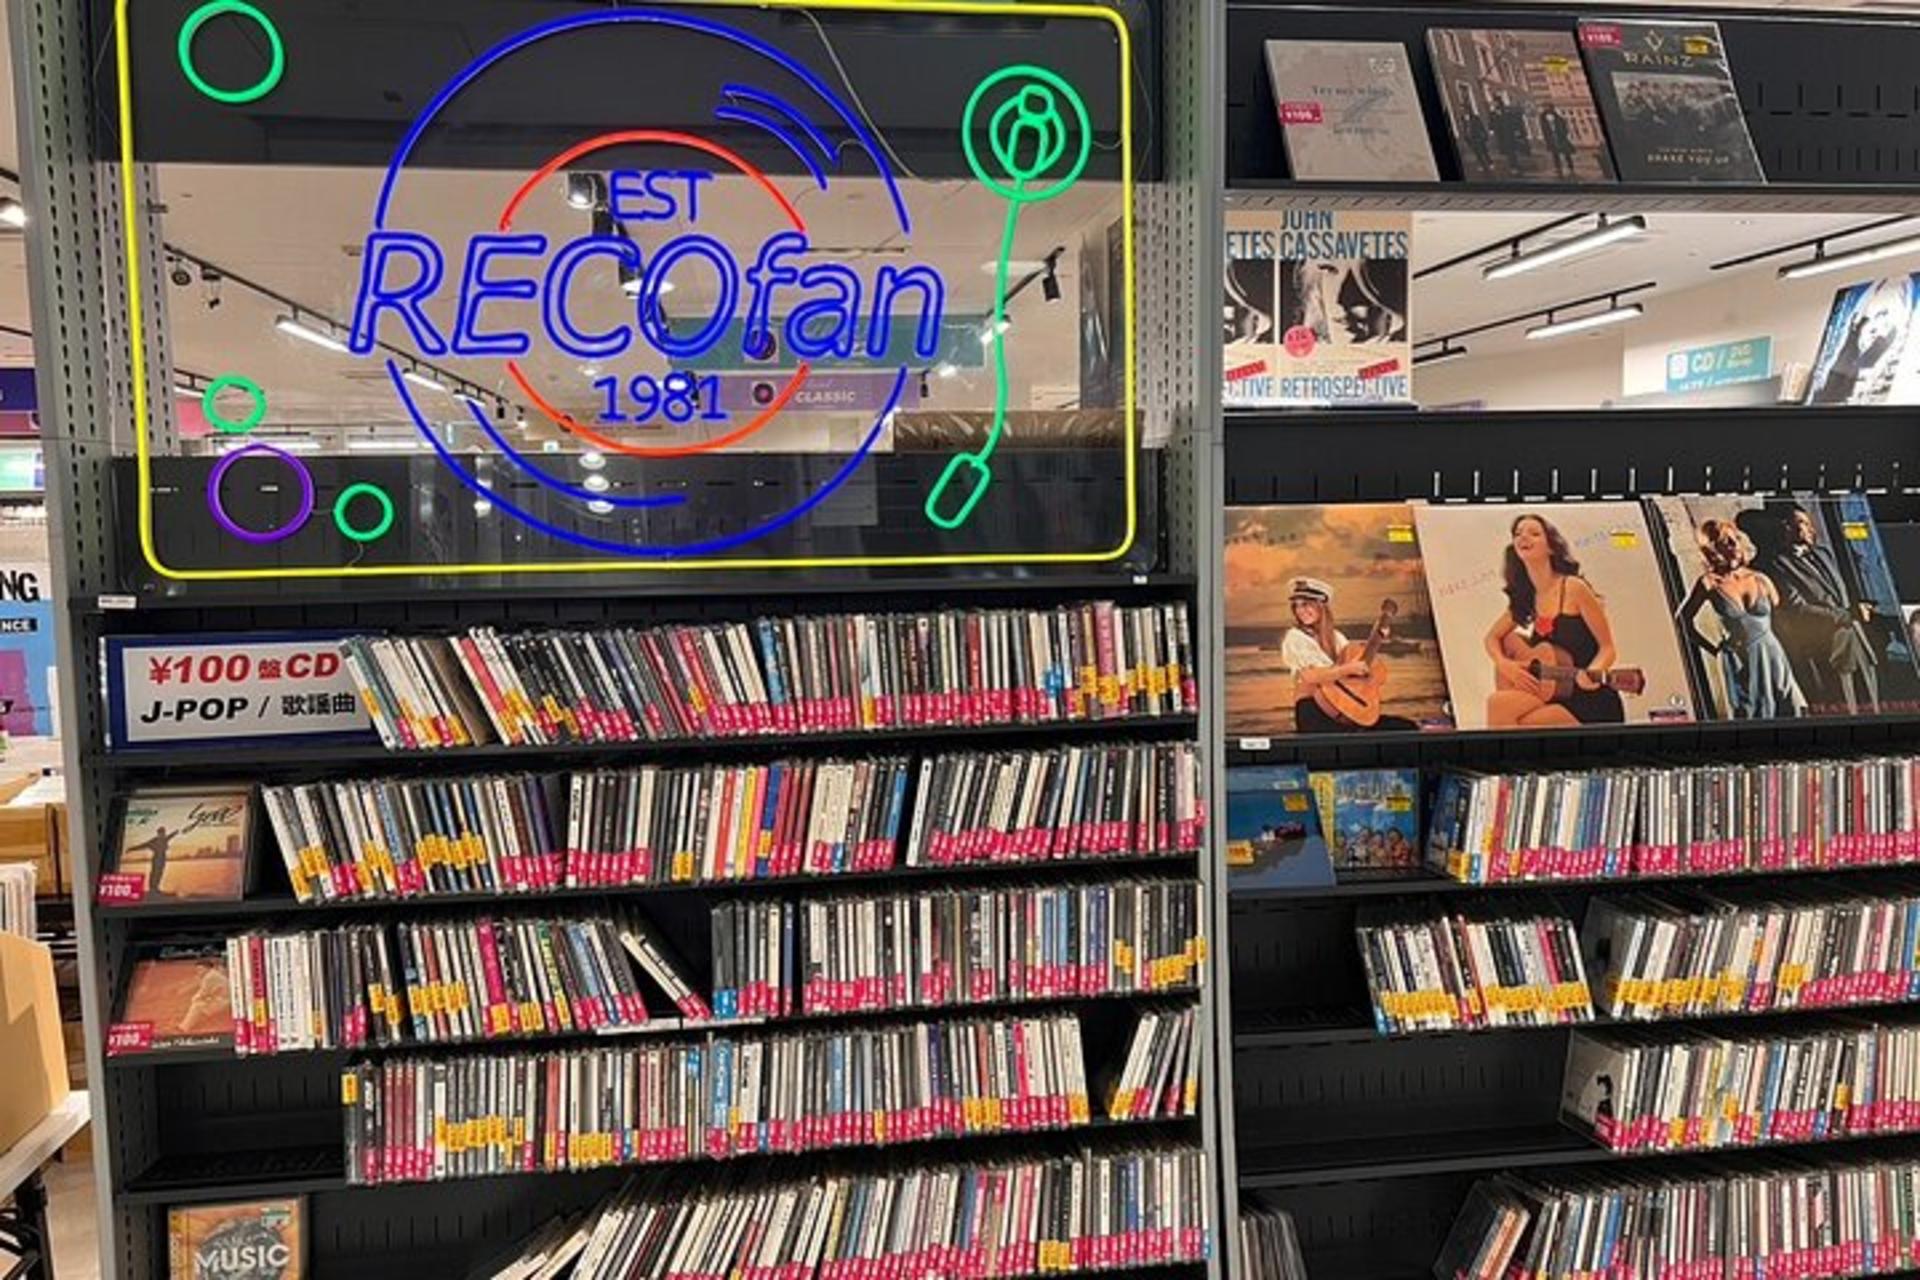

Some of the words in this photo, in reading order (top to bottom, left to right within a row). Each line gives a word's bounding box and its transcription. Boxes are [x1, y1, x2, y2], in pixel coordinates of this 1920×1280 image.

[1623, 52, 1694, 68] RAINZ
[610, 171, 711, 221] EST
[1280, 210, 1334, 229] JOHN
[1226, 232, 1275, 259] ETES
[1280, 232, 1408, 259] CASSAVETES
[350, 231, 945, 357] RECOfan
[1690, 351, 1714, 373] CD
[593, 373, 726, 423] 1981
[795, 390, 856, 404] CLASSIC
[140, 697, 248, 723] J-POP
[281, 692, 356, 716] 歌謡曲
[194, 1243, 290, 1274] MUSIC
